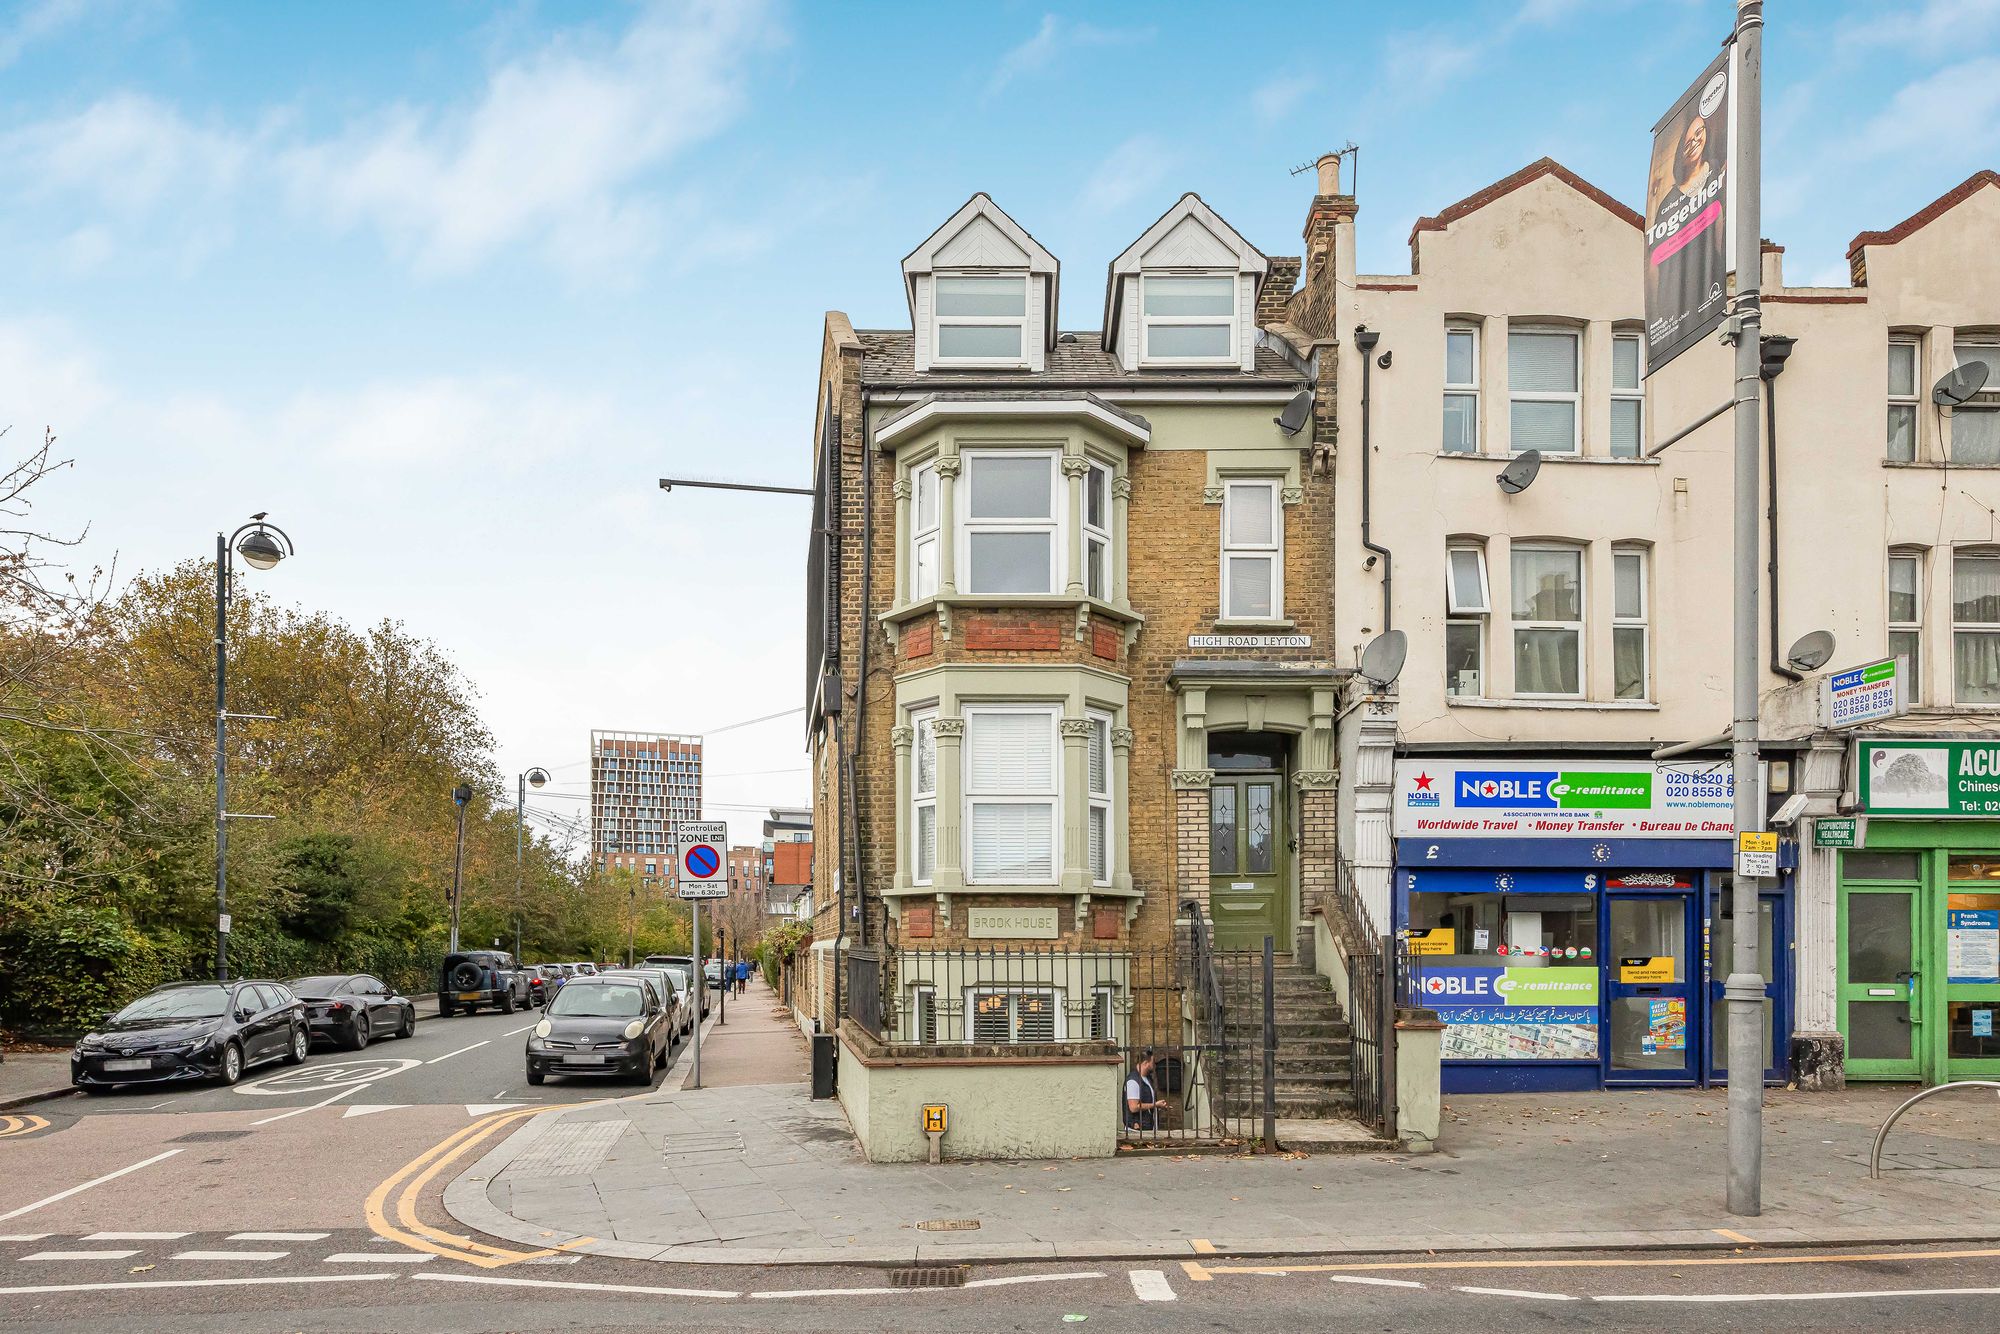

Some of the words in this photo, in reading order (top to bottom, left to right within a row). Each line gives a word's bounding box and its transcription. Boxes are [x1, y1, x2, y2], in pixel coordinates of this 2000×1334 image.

[1646, 170, 1726, 246] Together
[1661, 200, 1679, 215] Caring
[1193, 636, 1222, 646] HIGH
[1228, 636, 1258, 646] ROAD
[1264, 636, 1306, 646] LEYTON
[1834, 674, 1859, 688] NOBLE
[1836, 688, 1858, 698] MONEY
[1859, 680, 1890, 693] TRANSFER
[1833, 699, 1848, 710] 020
[1850, 694, 1870, 705] 8520
[1872, 689, 1892, 700] 8261
[1833, 708, 1848, 718] 020
[1850, 703, 1870, 714] 8558
[1872, 698, 1893, 709] 6356
[1666, 774, 1689, 784] 020
[1692, 774, 1723, 784] 8520
[1959, 780, 2000, 792] Chines
[1462, 780, 1541, 798] NOBLE
[1553, 784, 1645, 795] e-remittance
[1666, 787, 1689, 797] 020
[1692, 787, 1722, 797] 8558
[1960, 800, 1981, 811] Tel:
[1984, 801, 2000, 811] 02
[1417, 820, 1479, 830] Worldwide
[1482, 820, 1518, 830] Travel
[1535, 820, 1573, 832] Money
[1578, 820, 1624, 831] Transfer
[1640, 822, 1680, 831] Bureau
[1685, 823, 1698, 831] De
[974, 918, 1012, 928] BROOK
[1015, 918, 1052, 928] HOUSE
[1408, 976, 1488, 994] NOBLE
[1500, 980, 1592, 991] e-remittance
[1570, 1009, 1590, 1024] پاکستان
[927, 1110, 942, 1129] H
